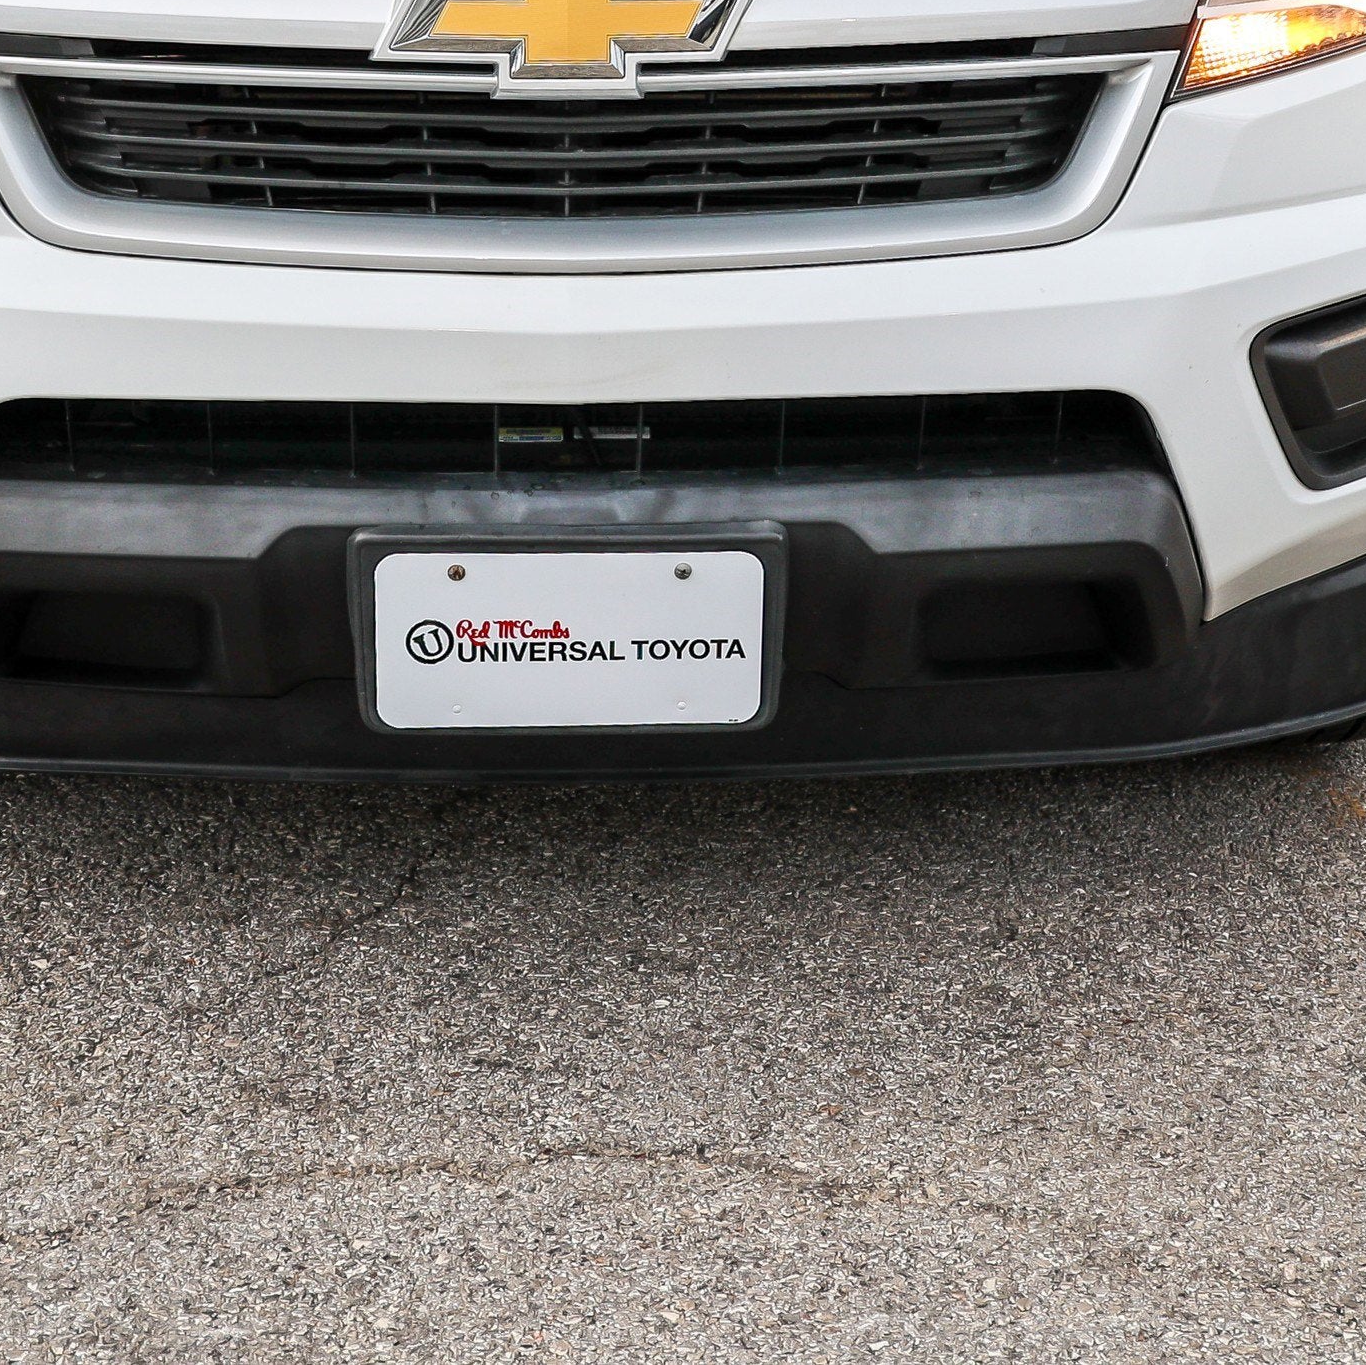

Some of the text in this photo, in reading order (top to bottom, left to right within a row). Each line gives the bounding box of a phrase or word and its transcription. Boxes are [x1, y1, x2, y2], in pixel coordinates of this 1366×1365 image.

[456, 619, 570, 646] Red McCombs
[458, 639, 746, 662] UNIVERSAL TOYOTA
